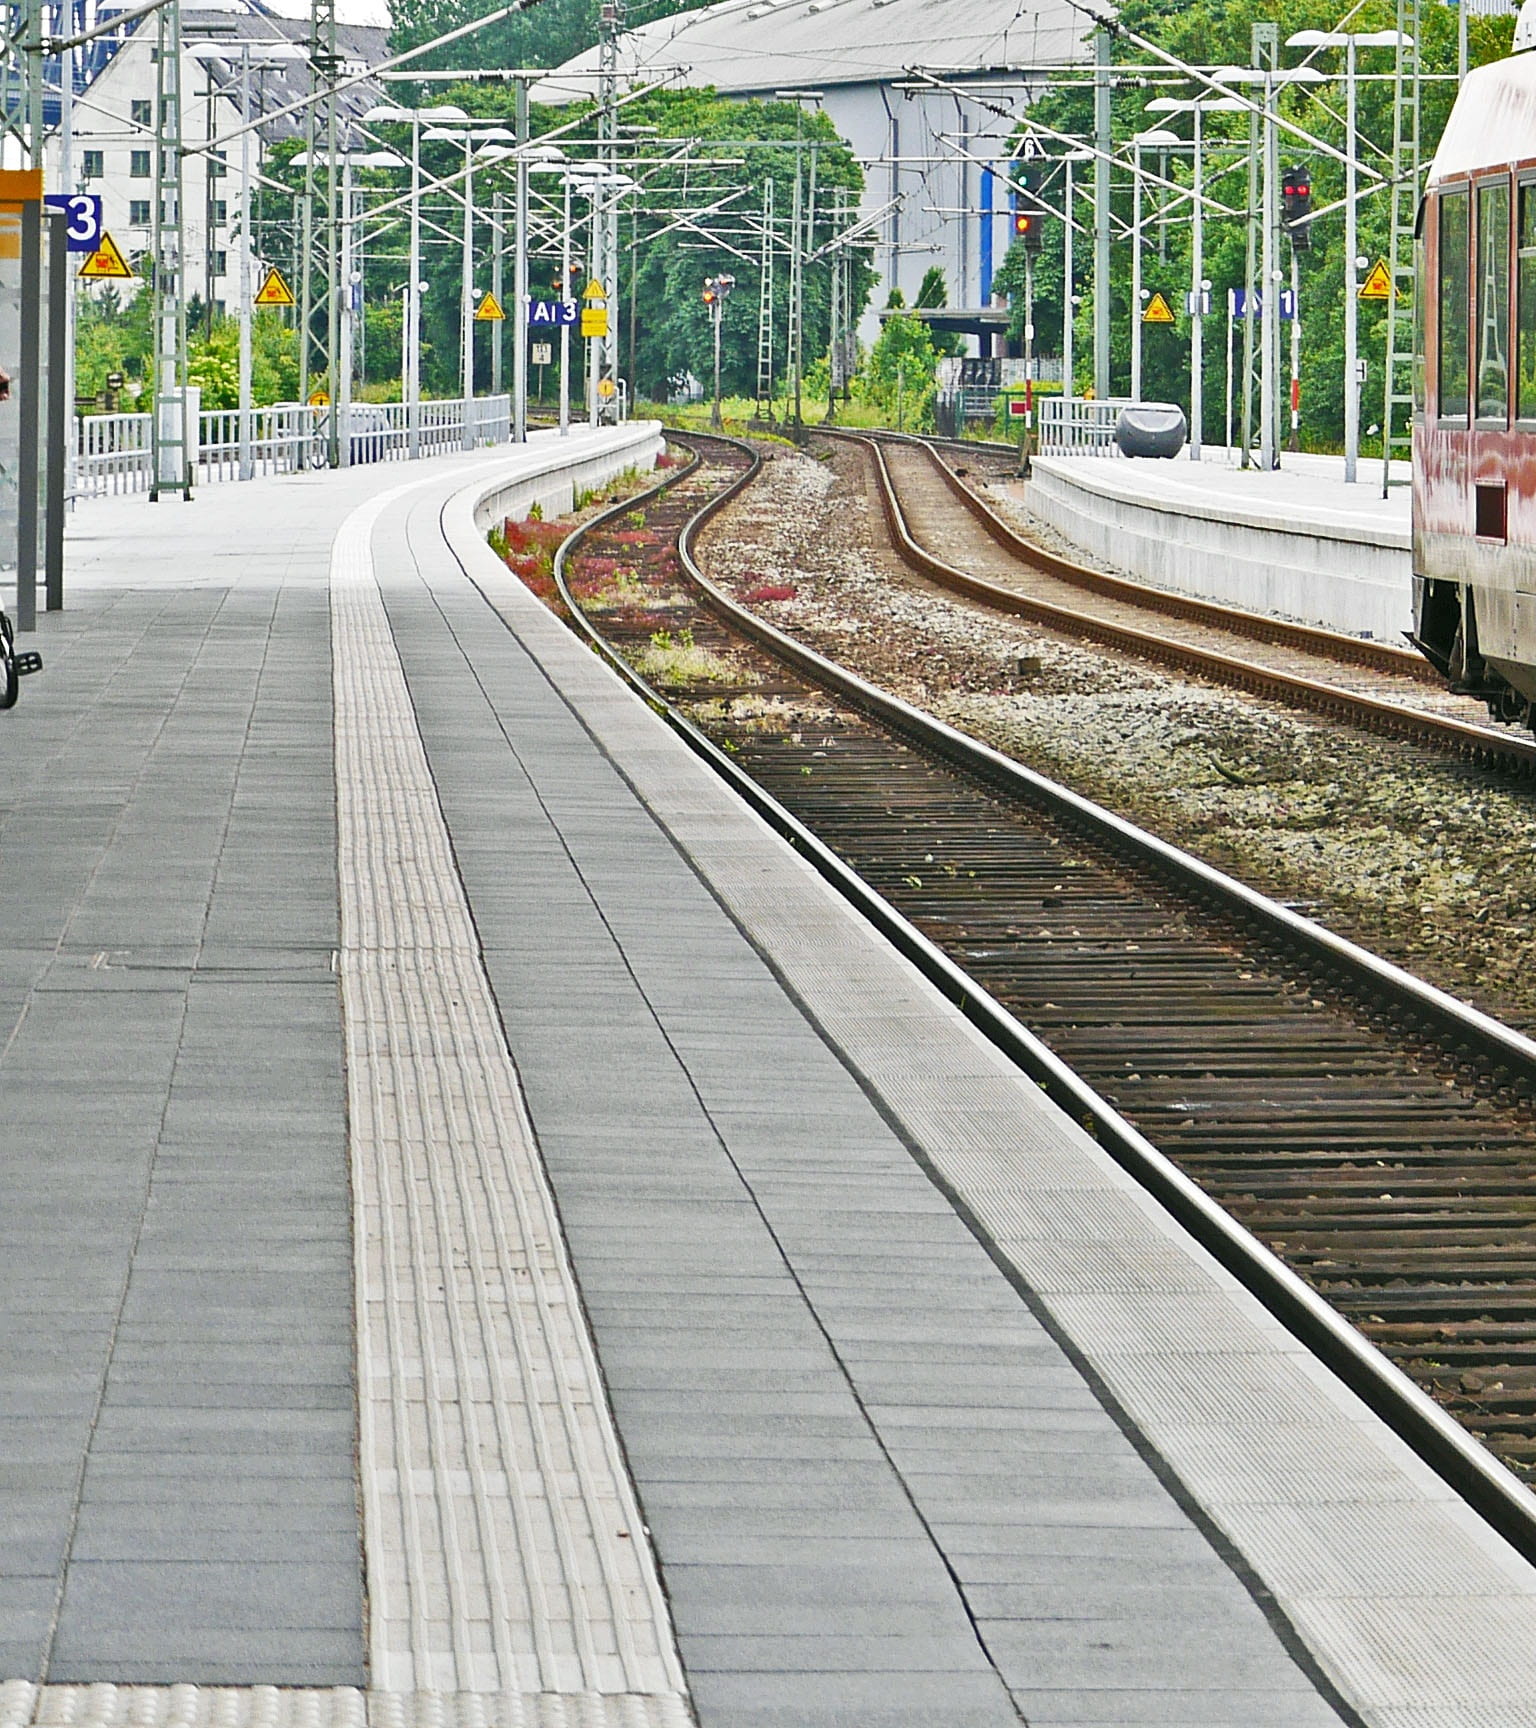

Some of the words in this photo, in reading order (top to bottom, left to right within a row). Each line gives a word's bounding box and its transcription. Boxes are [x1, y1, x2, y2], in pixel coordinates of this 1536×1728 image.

[66, 196, 97, 241] 3
[534, 302, 550, 321] A
[562, 302, 576, 321] 3
[1281, 290, 1292, 313] 1
